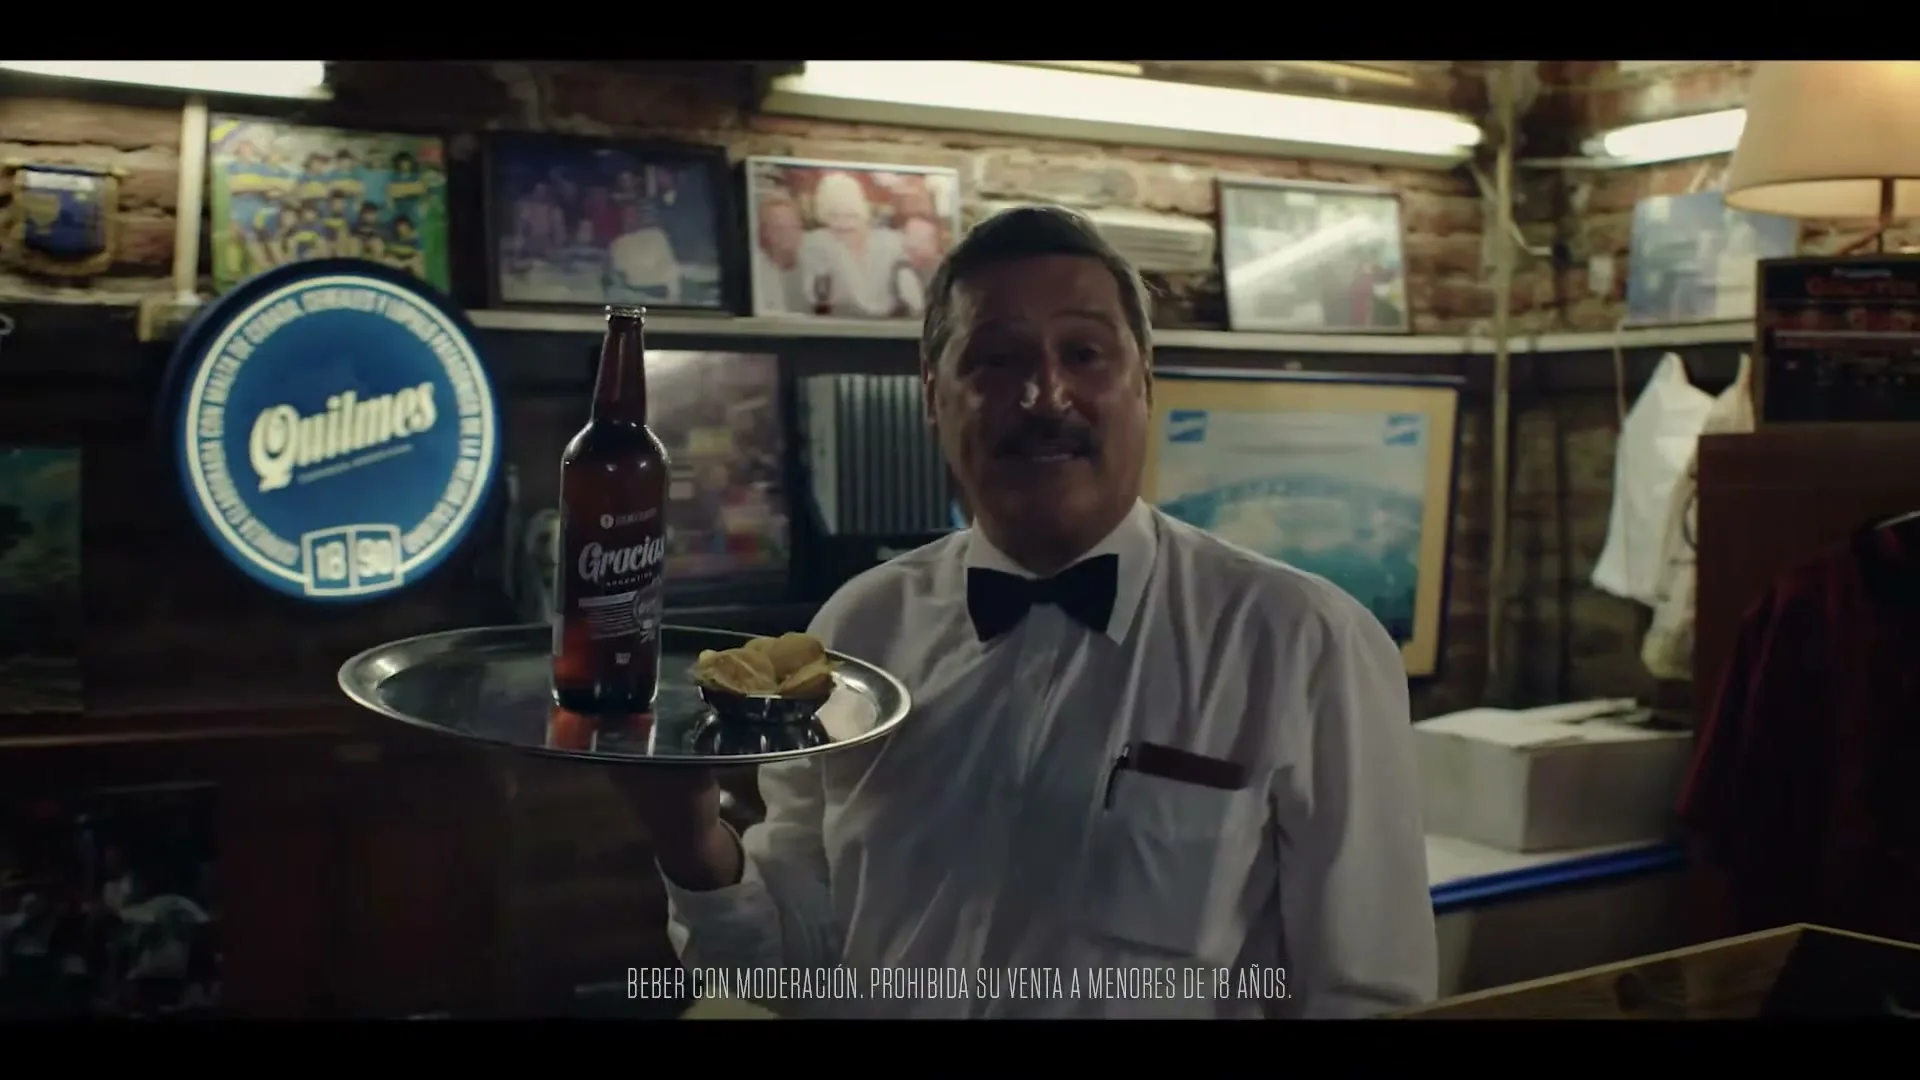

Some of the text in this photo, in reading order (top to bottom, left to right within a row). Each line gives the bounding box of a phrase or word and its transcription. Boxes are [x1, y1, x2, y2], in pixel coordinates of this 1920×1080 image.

[249, 382, 438, 492] Quilmes
[315, 538, 393, 580] 18 90
[578, 534, 665, 583] Gracias
